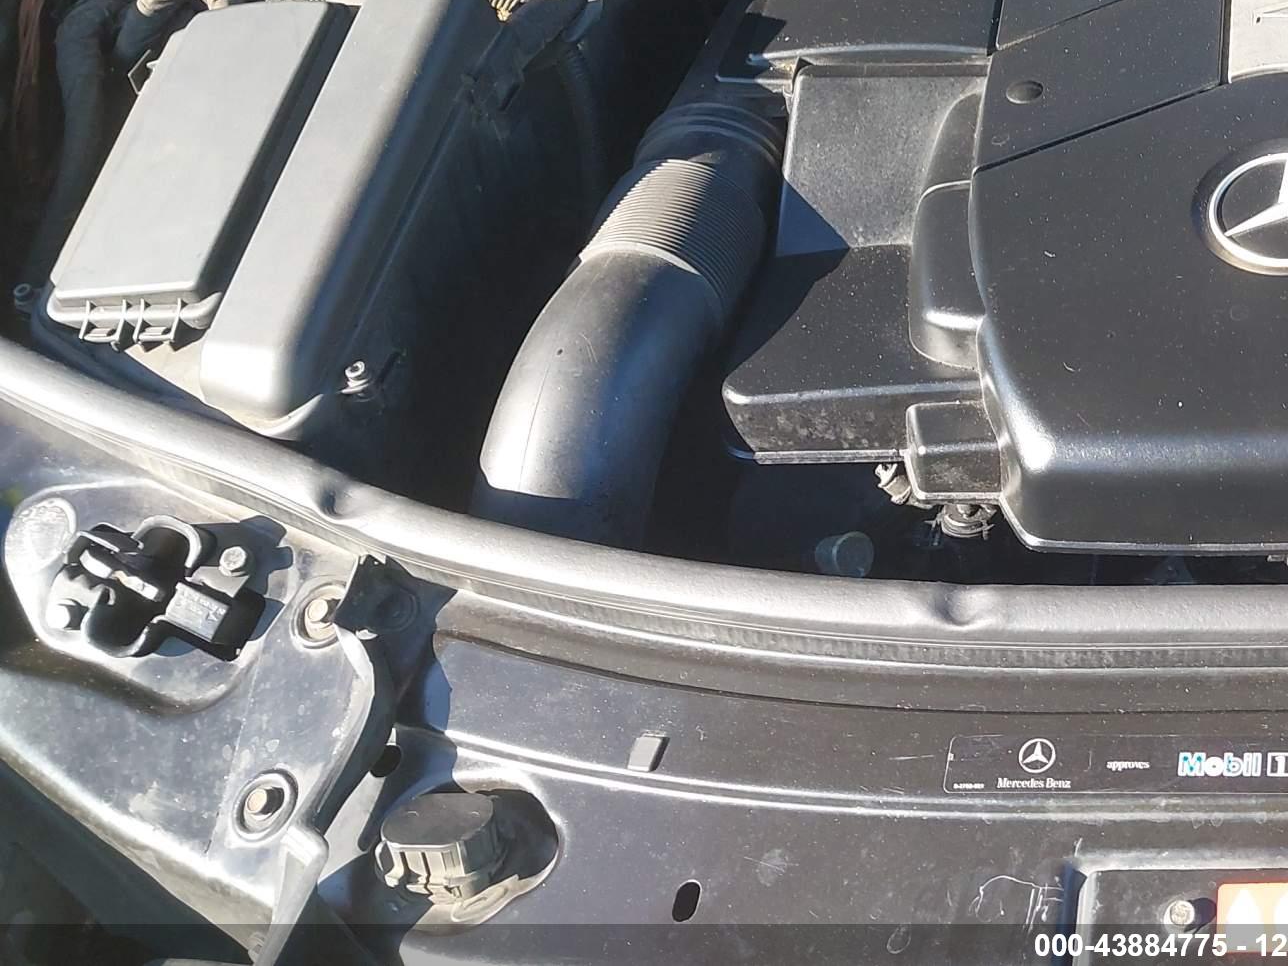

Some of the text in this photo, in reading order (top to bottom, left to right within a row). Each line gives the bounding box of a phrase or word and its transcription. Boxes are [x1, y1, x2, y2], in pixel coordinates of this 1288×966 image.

[1107, 760, 1150, 771] approves
[1178, 752, 1262, 777] Mobil
[997, 777, 1044, 789] Mercedes
[1046, 777, 1071, 789] Benz
